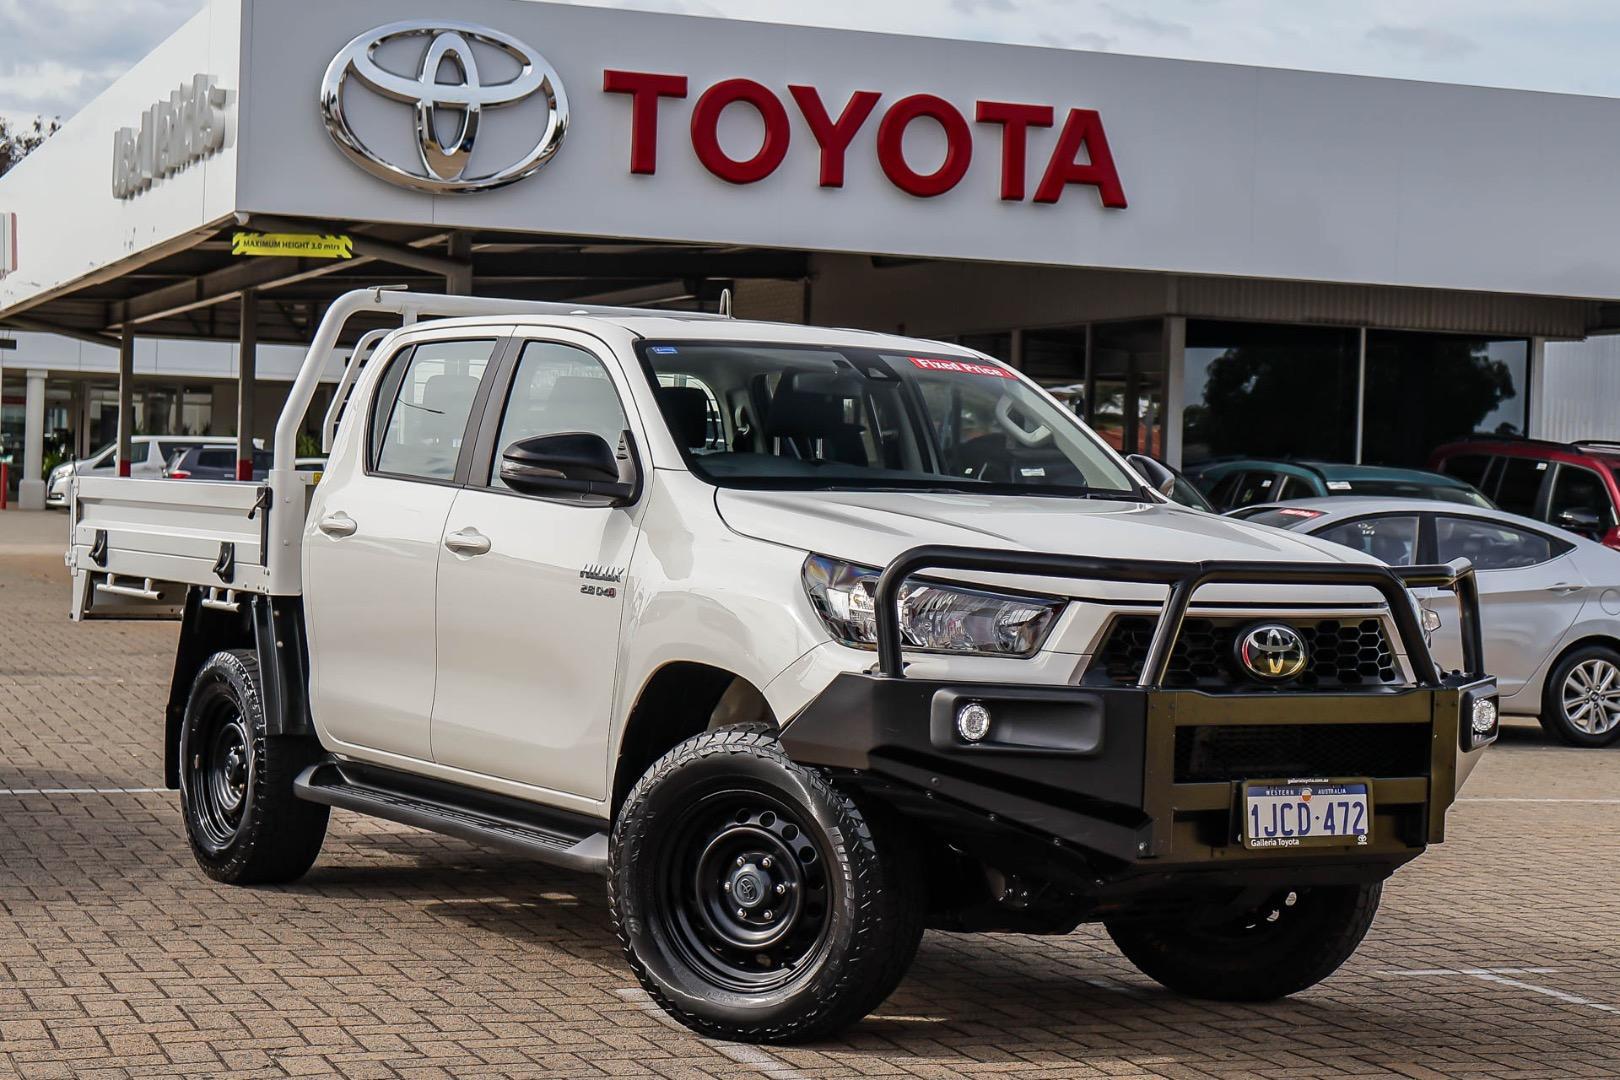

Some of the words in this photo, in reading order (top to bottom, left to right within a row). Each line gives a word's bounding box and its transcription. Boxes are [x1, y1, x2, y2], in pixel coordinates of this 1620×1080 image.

[603, 69, 1127, 209] TOYOTA
[243, 240, 280, 249] MAXIMUM
[281, 242, 310, 250] HEIGHT
[918, 359, 960, 371] Fixed
[960, 363, 1003, 377] Price
[1250, 838, 1277, 847] Galleria
[1278, 838, 1300, 848] Toyota
